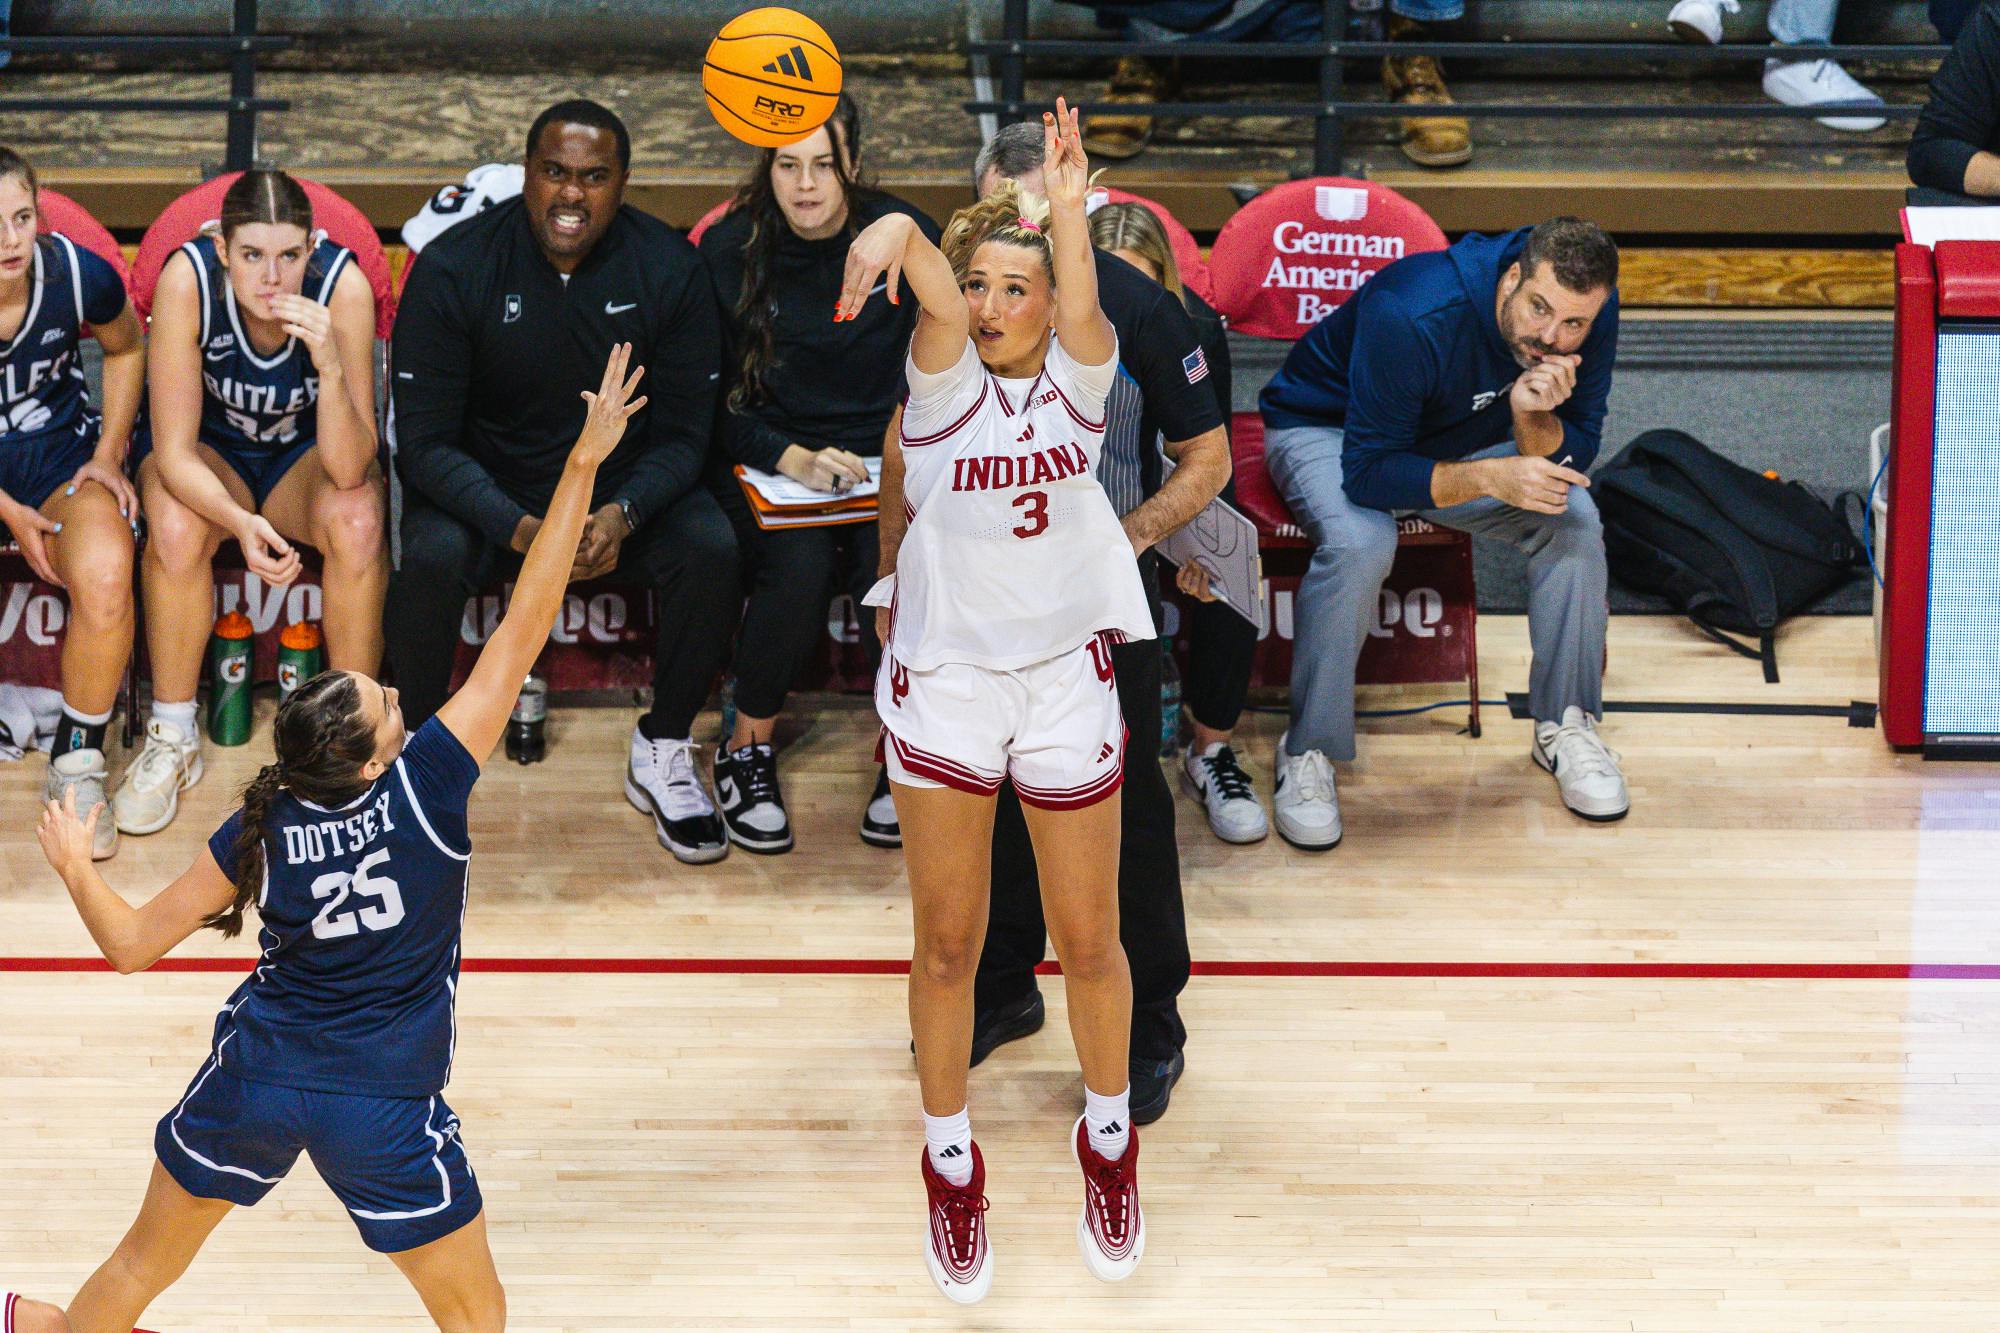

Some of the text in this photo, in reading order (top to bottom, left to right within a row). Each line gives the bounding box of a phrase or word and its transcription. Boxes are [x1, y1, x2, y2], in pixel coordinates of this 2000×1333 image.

[754, 95, 805, 117] PRO
[1272, 221, 1405, 259] German
[1261, 256, 1377, 291] Americ
[1296, 293, 1341, 324] Ba
[952, 441, 1090, 492] INDIANA
[1012, 490, 1049, 539] 3
[220, 655, 246, 684] G
[283, 791, 395, 865] DOTSEY
[310, 847, 405, 939] 25
